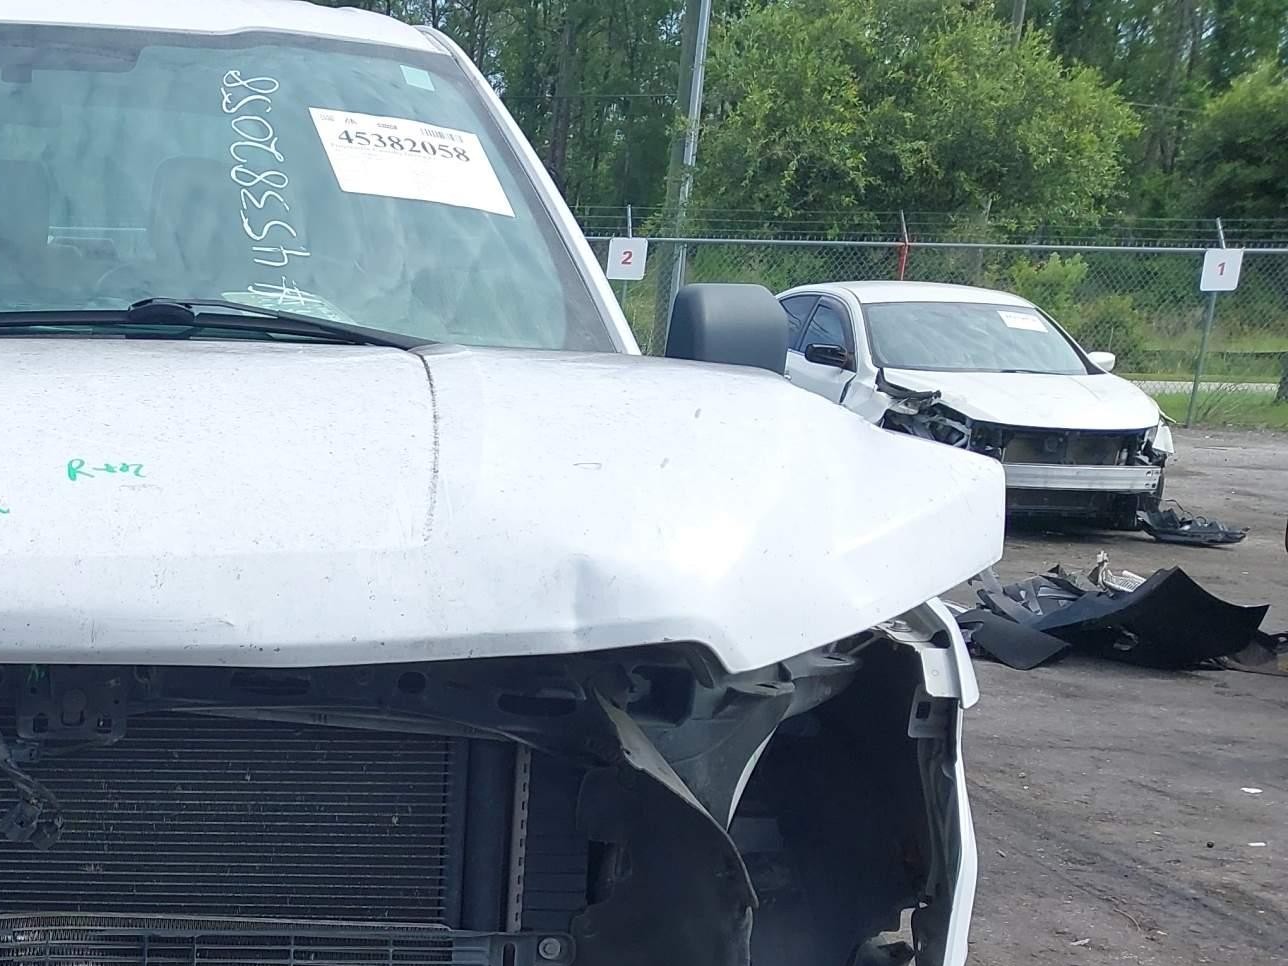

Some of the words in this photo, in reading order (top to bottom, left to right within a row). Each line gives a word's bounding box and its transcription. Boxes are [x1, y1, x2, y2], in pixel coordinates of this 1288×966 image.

[338, 128, 471, 162] 45382058
[620, 250, 633, 265] 2
[1217, 261, 1226, 276] 1
